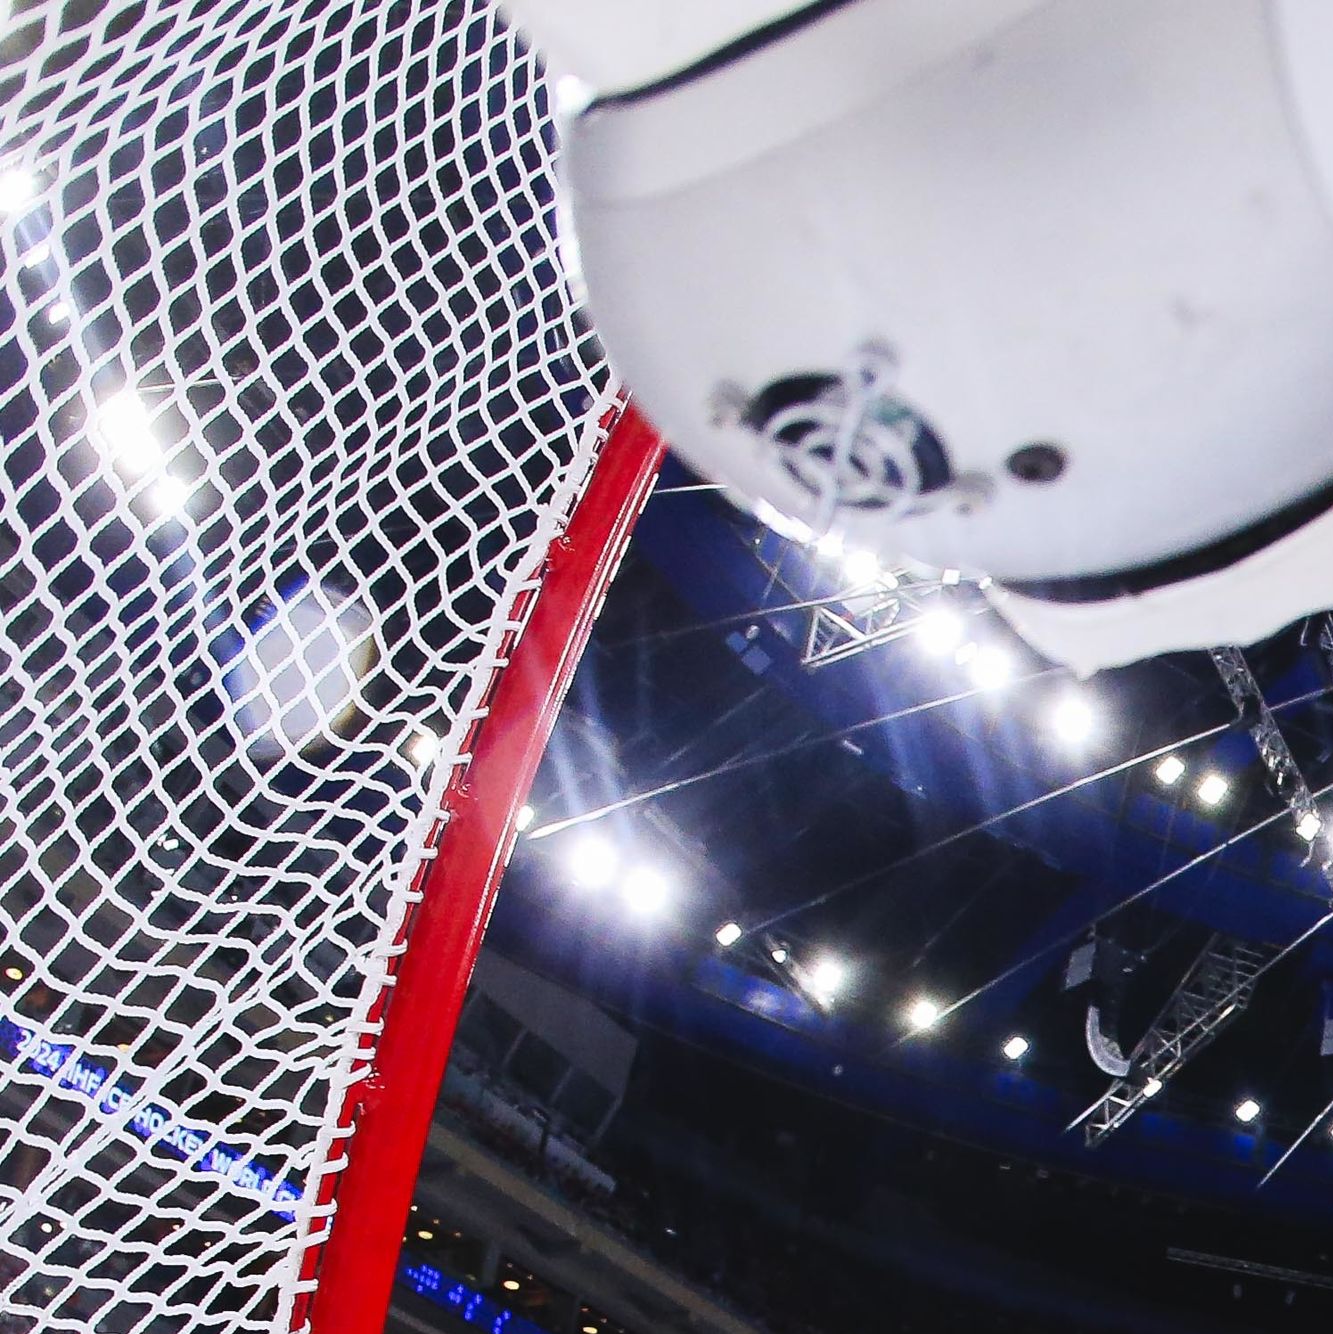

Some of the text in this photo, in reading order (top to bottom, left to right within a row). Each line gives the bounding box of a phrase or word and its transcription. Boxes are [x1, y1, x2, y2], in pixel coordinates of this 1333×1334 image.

[17, 1030, 61, 1073] 224
[134, 1108, 204, 1156] HOKE
[211, 1149, 273, 1194] WRLD
